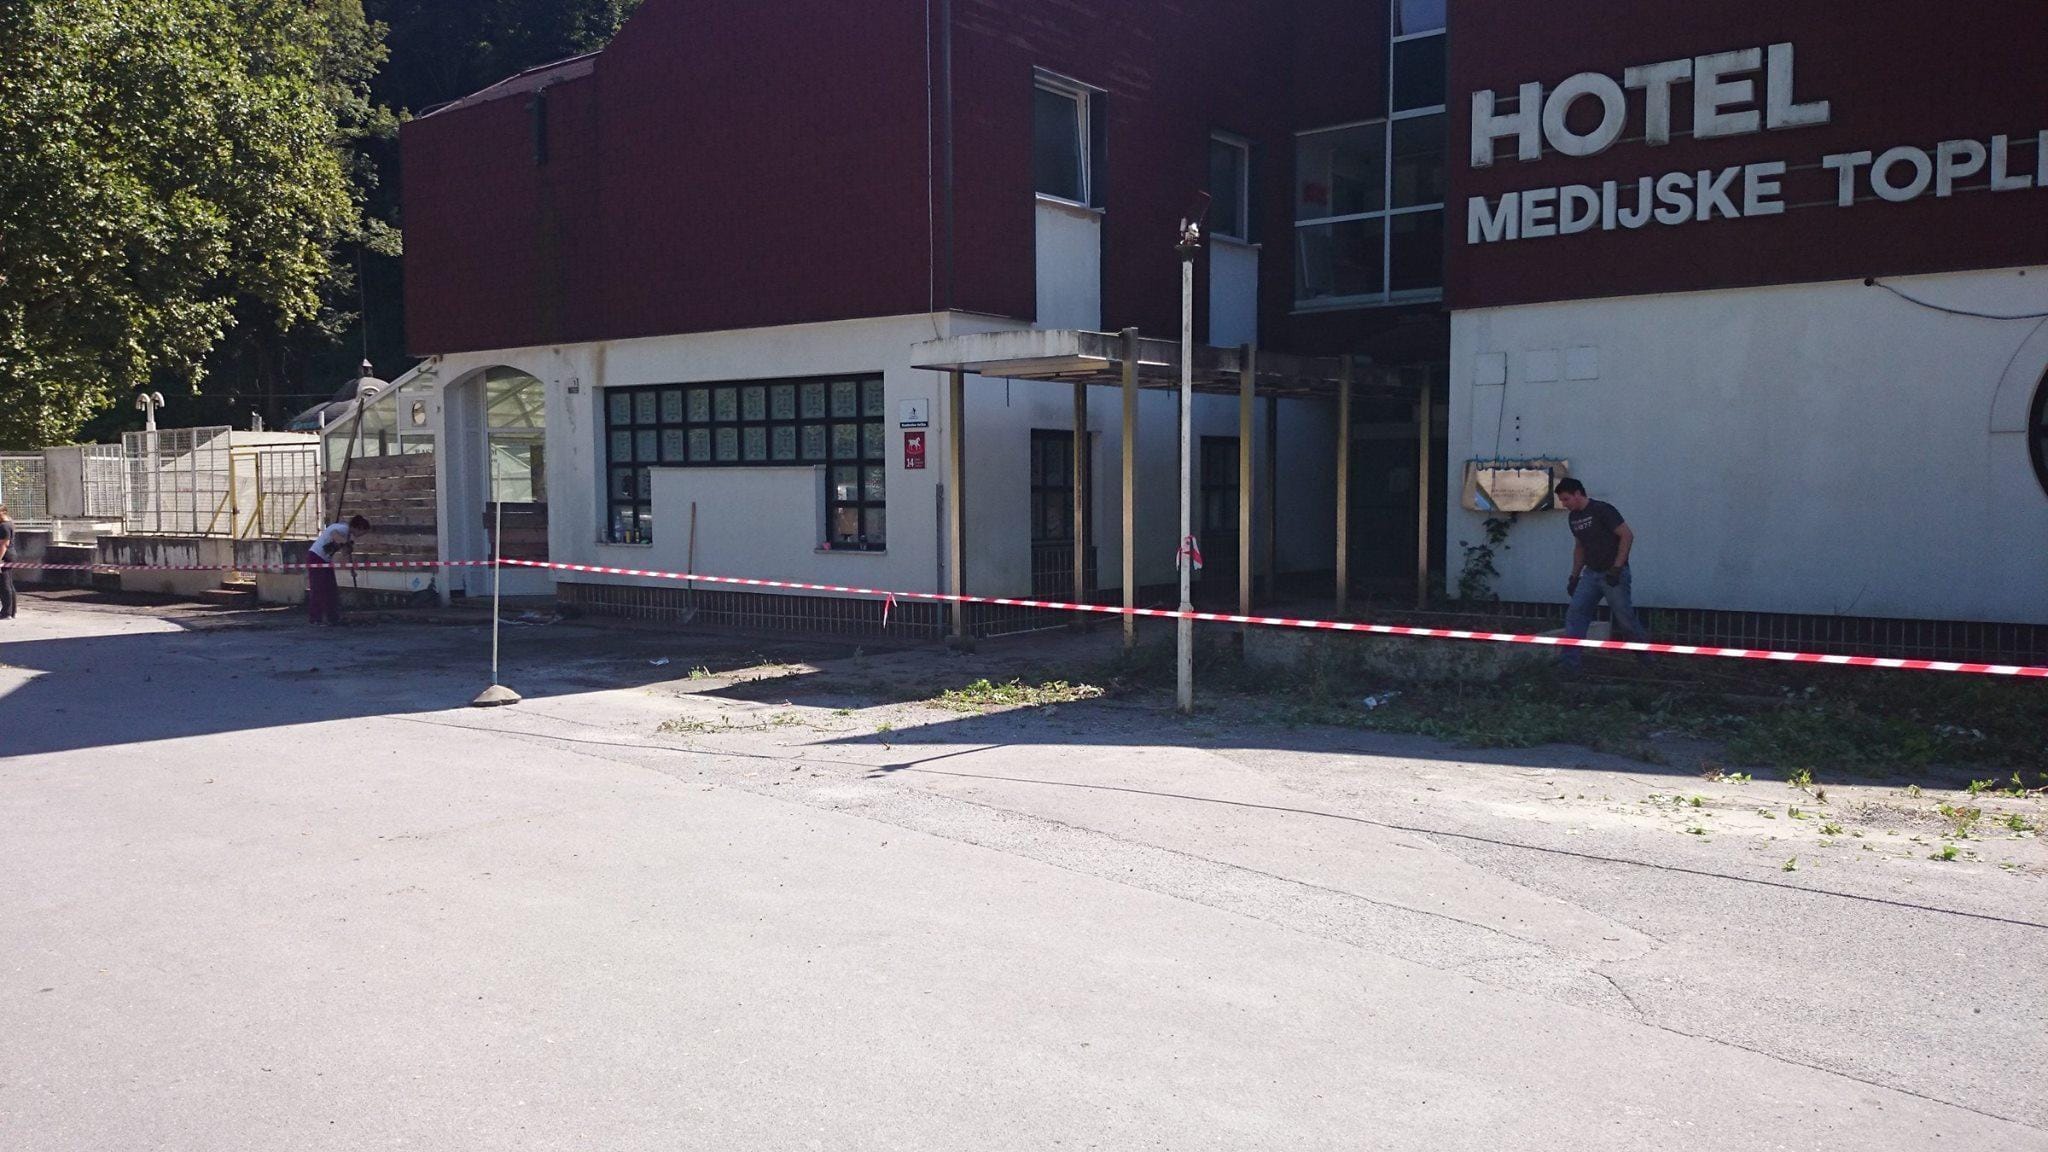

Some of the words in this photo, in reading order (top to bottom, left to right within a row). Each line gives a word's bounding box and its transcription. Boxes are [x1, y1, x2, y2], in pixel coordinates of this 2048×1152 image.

[1470, 42, 1831, 168] HOTEL
[1467, 160, 1787, 245] MEDIJSKE
[1822, 128, 2048, 207] TOPLI
[906, 458, 914, 467] 14
